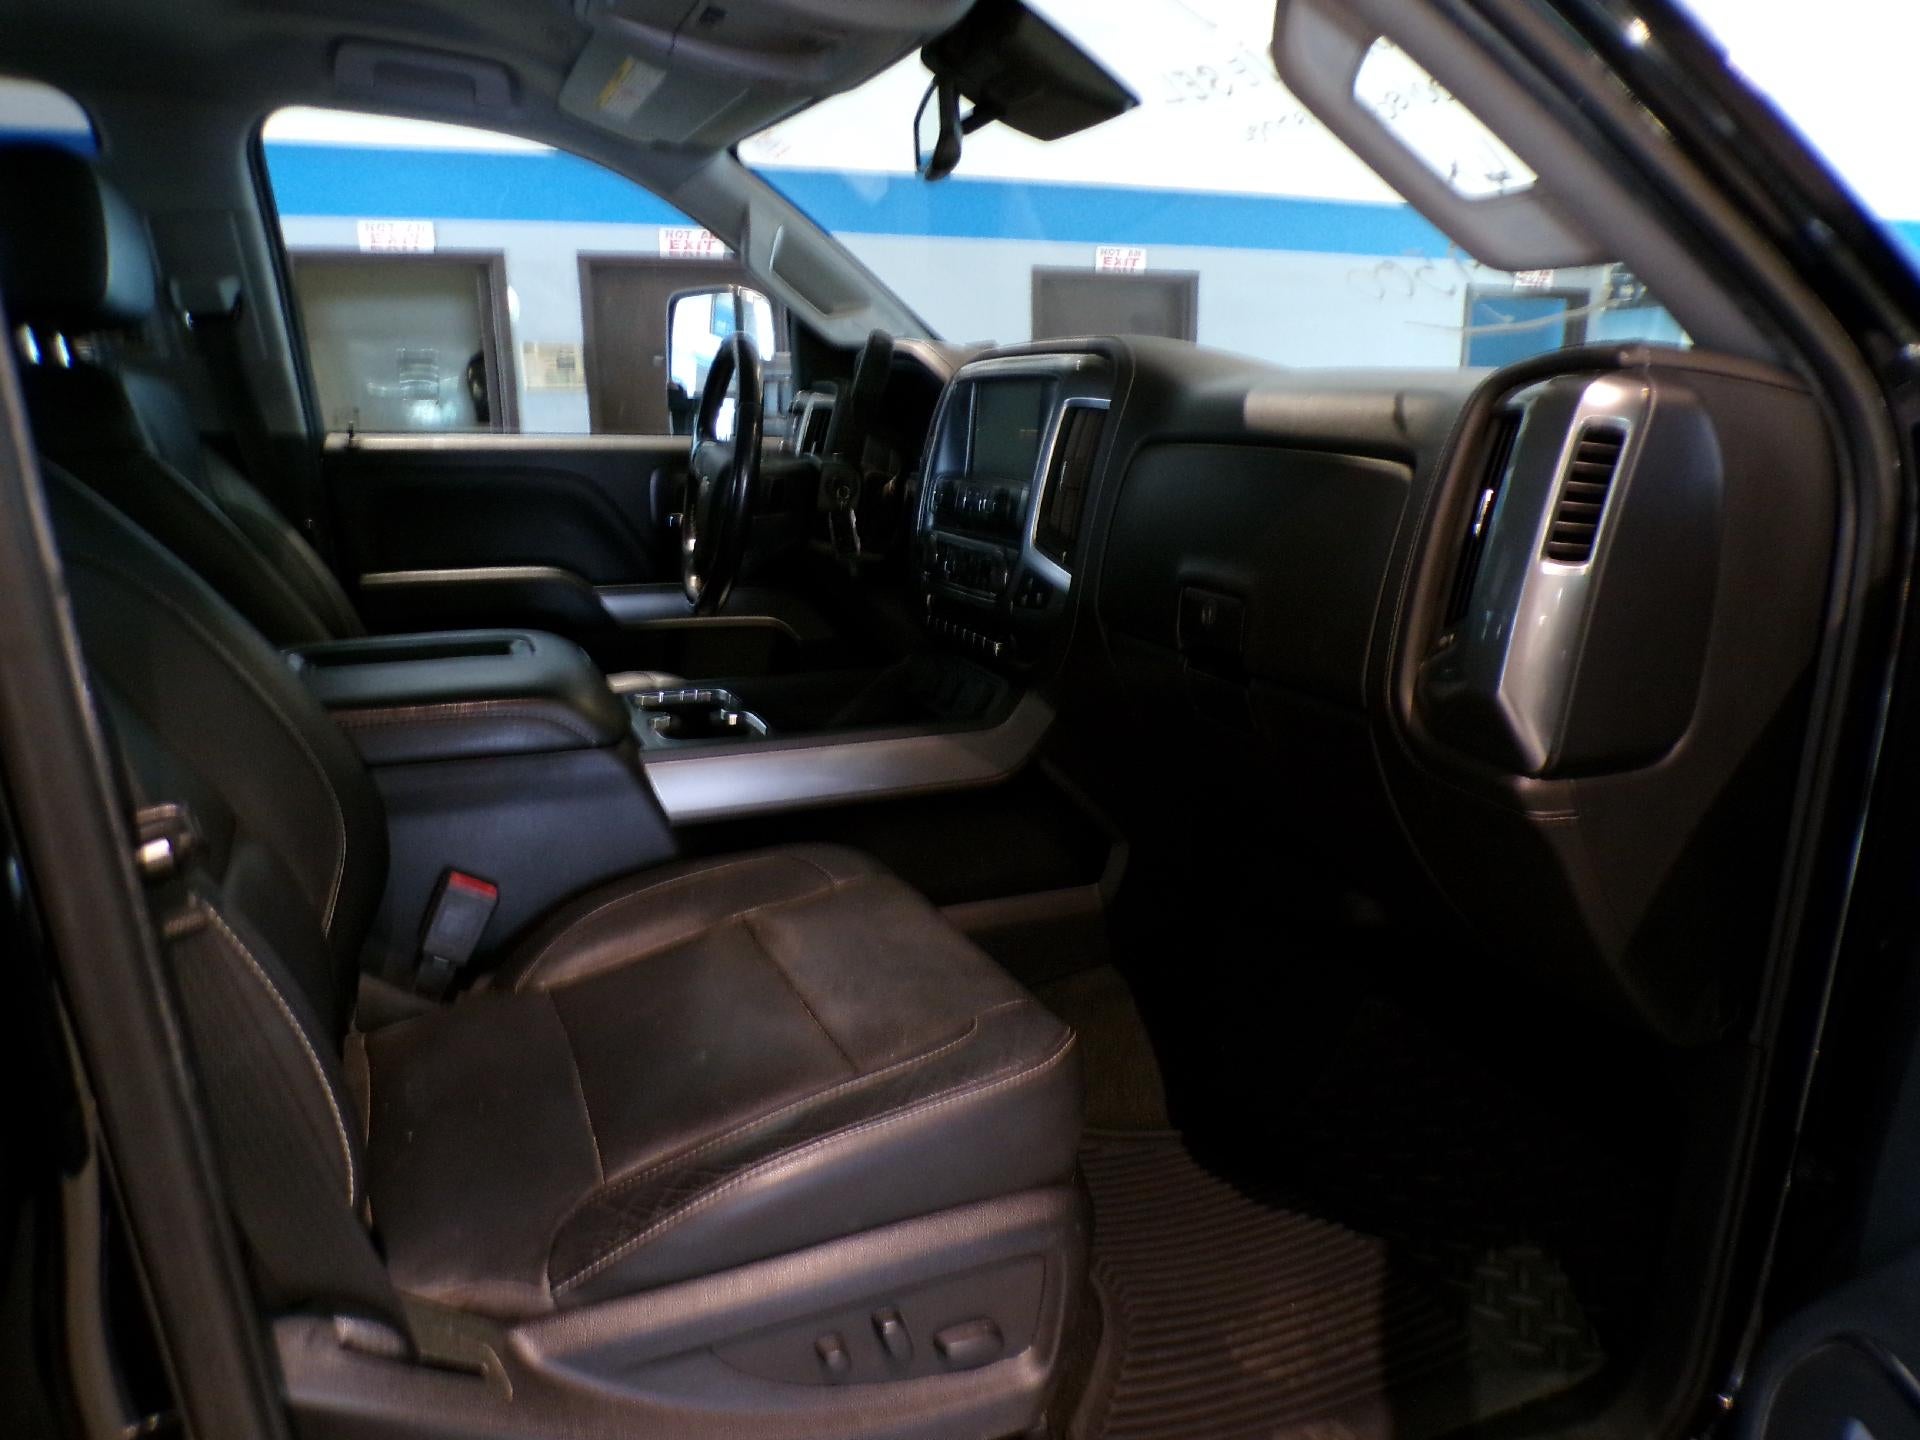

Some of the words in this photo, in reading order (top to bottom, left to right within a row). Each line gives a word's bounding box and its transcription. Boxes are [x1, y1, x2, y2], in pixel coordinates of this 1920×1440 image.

[664, 229, 692, 239] NOT
[668, 239, 717, 252] EXIT
[1100, 247, 1121, 256] NOT
[1103, 256, 1140, 268] EXIT
